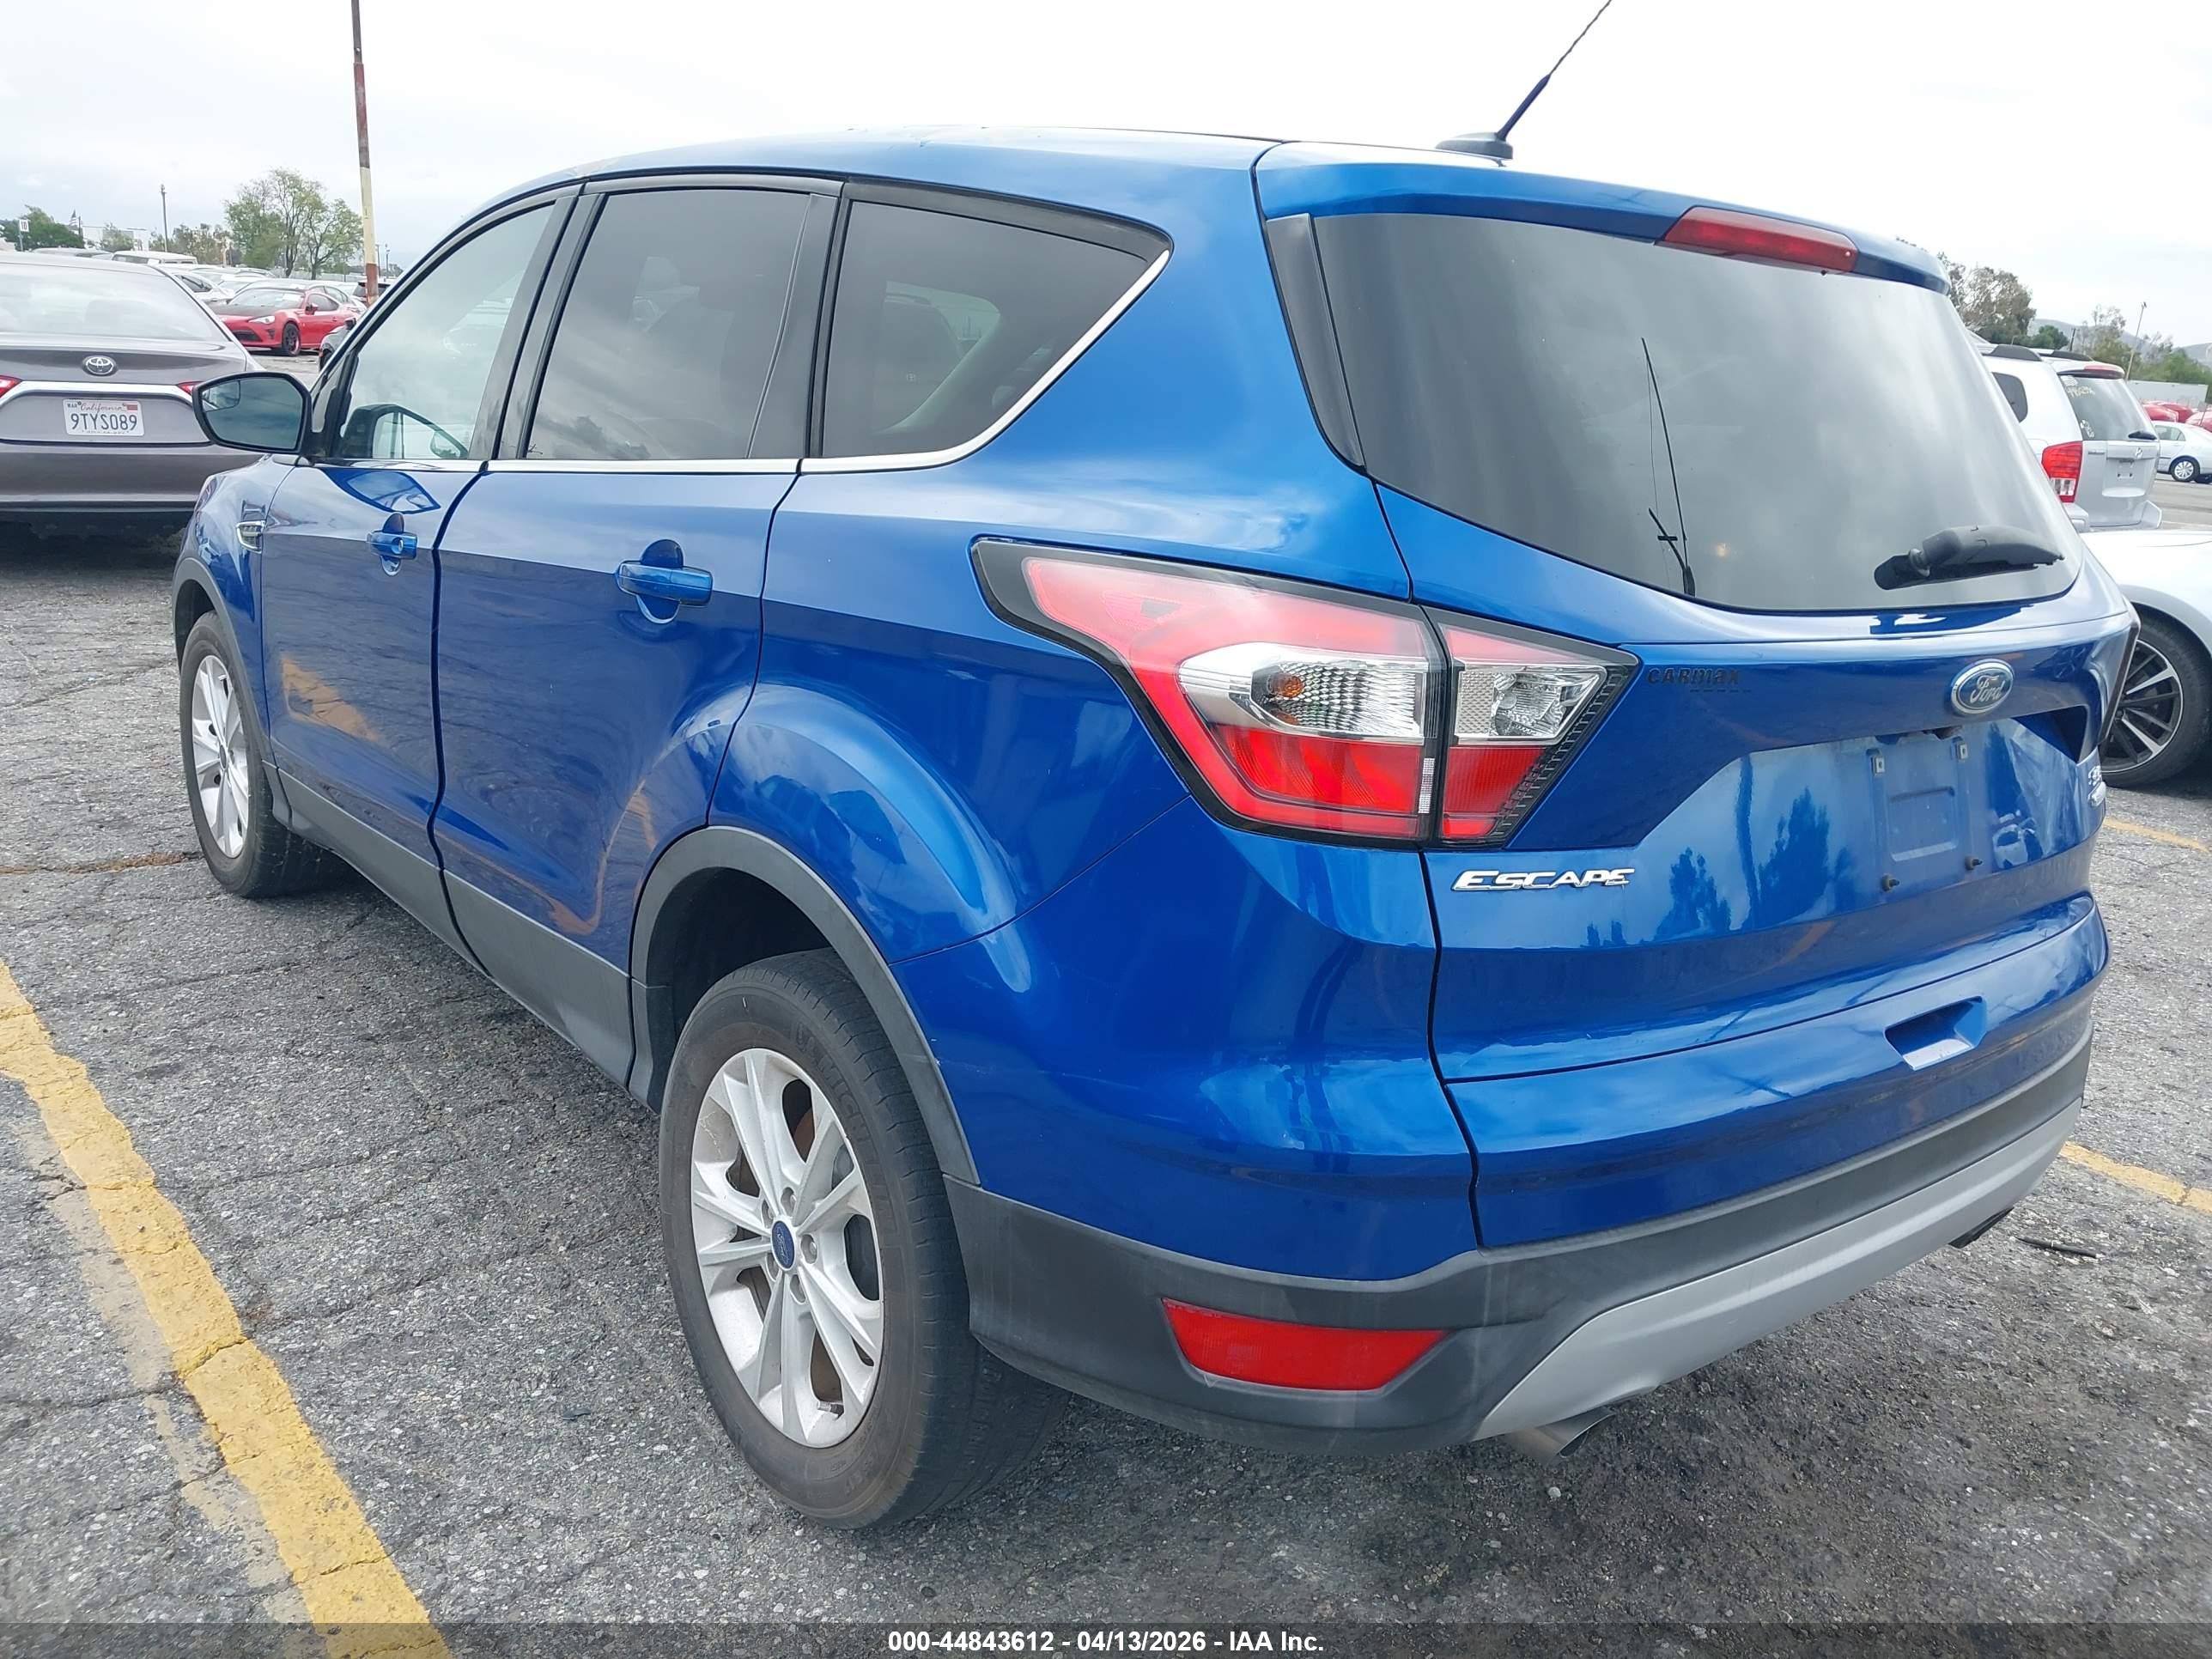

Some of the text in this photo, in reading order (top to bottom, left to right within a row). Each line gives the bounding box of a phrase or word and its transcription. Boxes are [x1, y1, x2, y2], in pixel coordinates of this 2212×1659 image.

[80, 402, 126, 413] California
[70, 413, 137, 430] 9TYS089
[1970, 674, 2006, 703] Ford
[1451, 868, 1635, 890] ESCAPE
